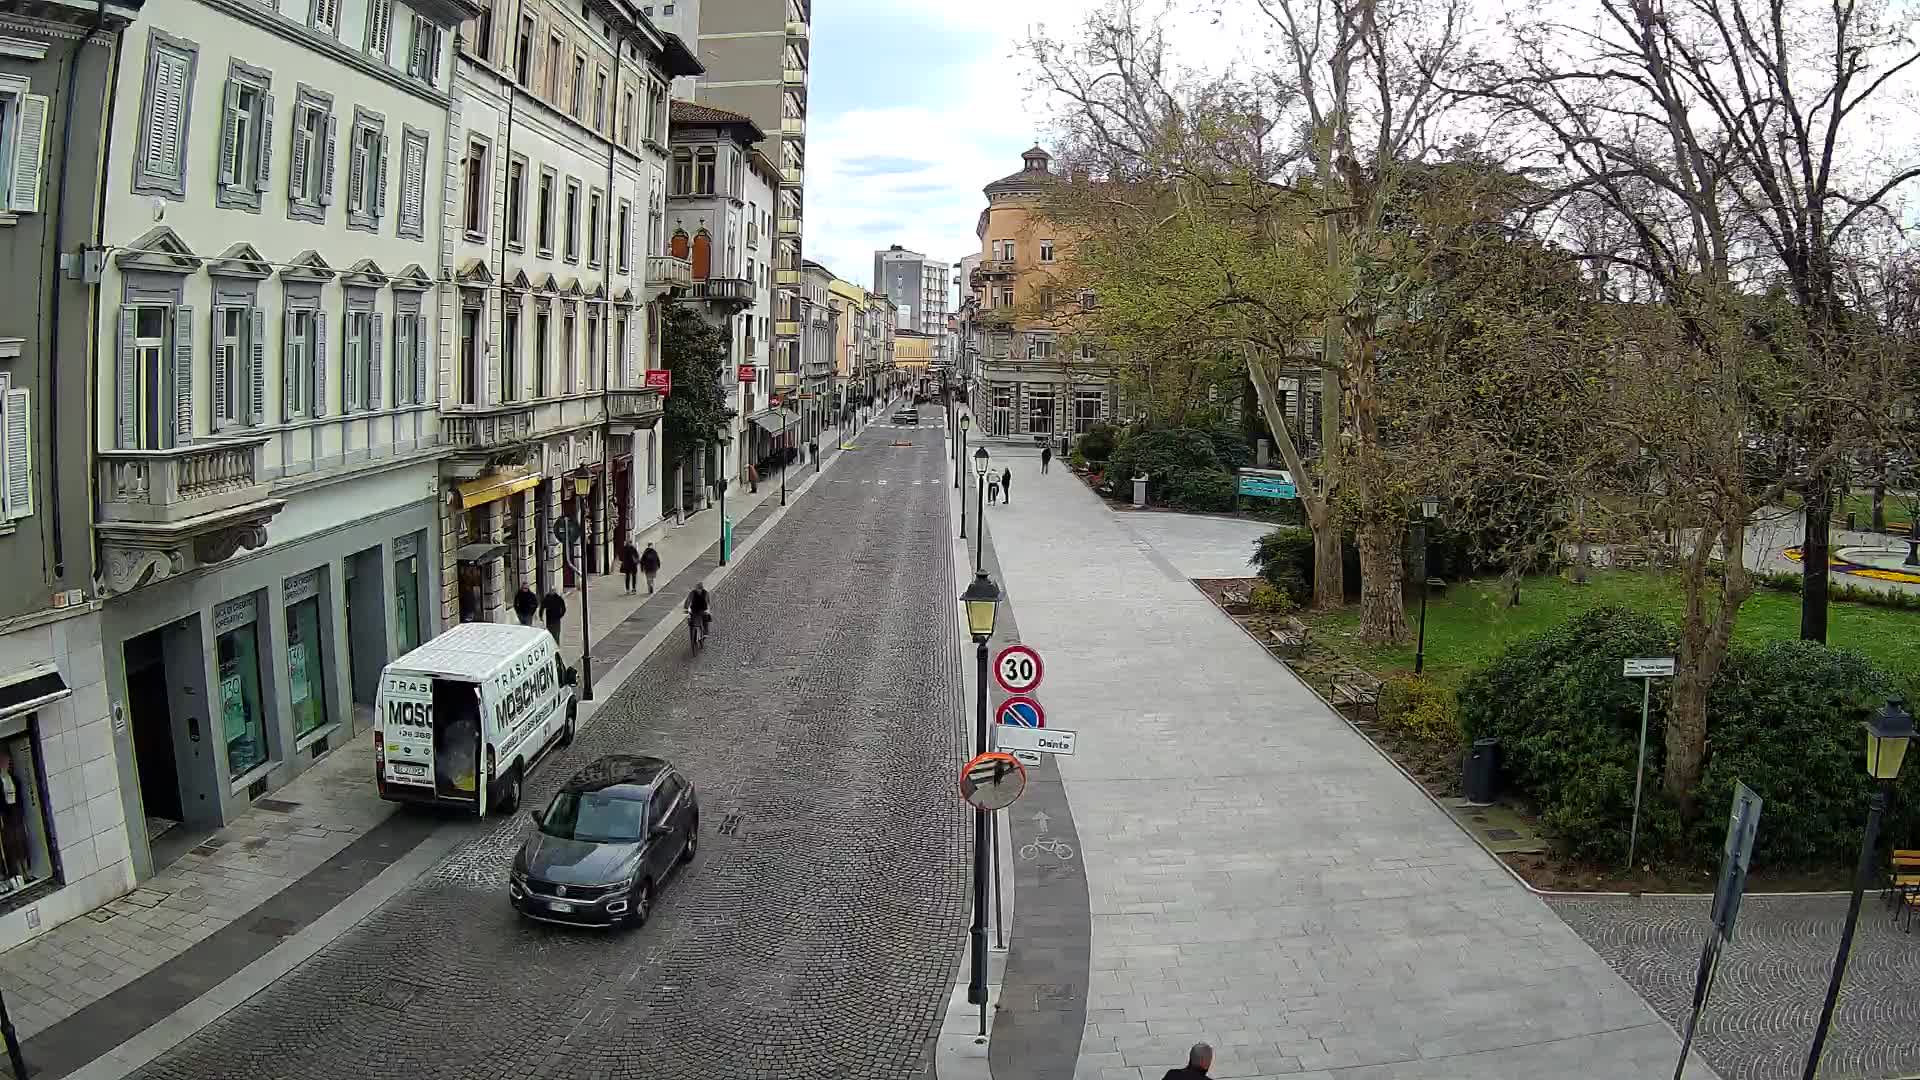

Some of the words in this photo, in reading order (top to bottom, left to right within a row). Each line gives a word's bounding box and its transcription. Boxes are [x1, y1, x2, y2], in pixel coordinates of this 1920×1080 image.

[494, 642, 549, 689] TRASLOCHI
[1004, 658, 1034, 681] 30
[495, 660, 555, 733] MOSCHION
[1038, 738, 1070, 749] Dante
